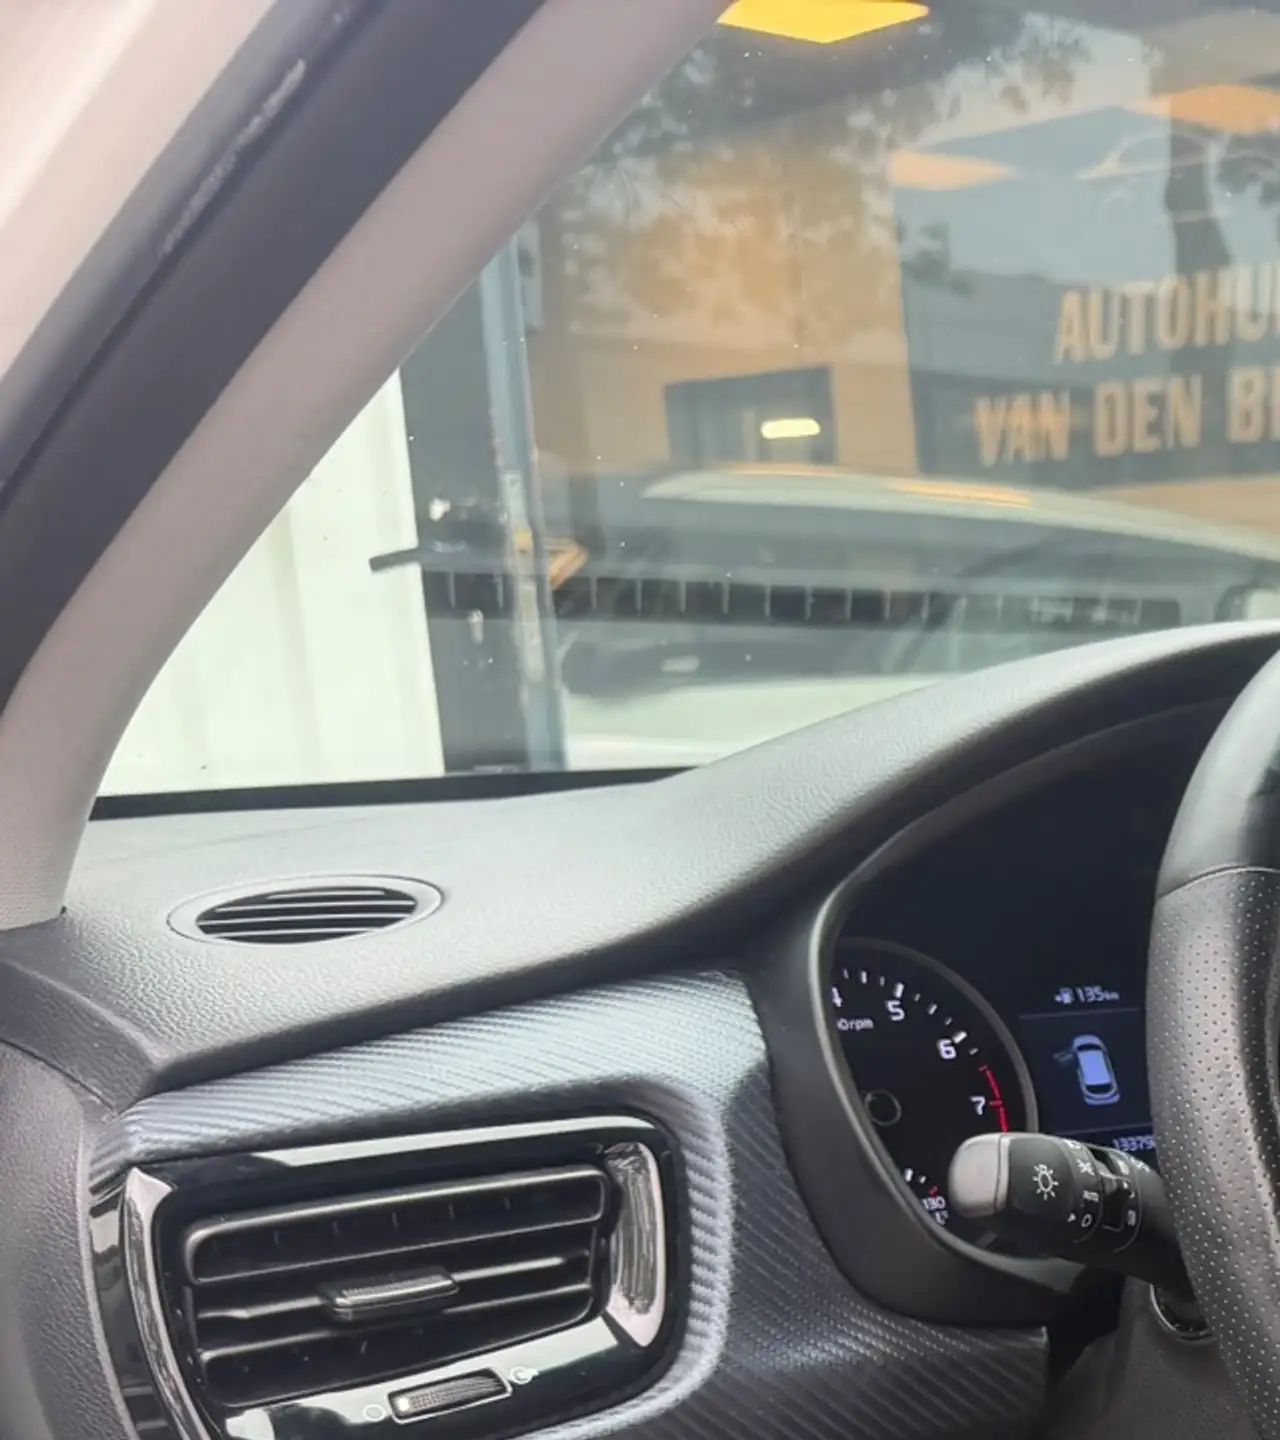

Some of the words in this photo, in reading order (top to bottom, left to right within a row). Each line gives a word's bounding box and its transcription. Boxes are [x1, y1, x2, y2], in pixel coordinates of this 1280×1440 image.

[973, 389, 1070, 467] VAN
[1093, 372, 1202, 457] DEN
[885, 1000, 905, 1021] 5
[937, 1038, 957, 1060] 6
[969, 1096, 986, 1116] 7
